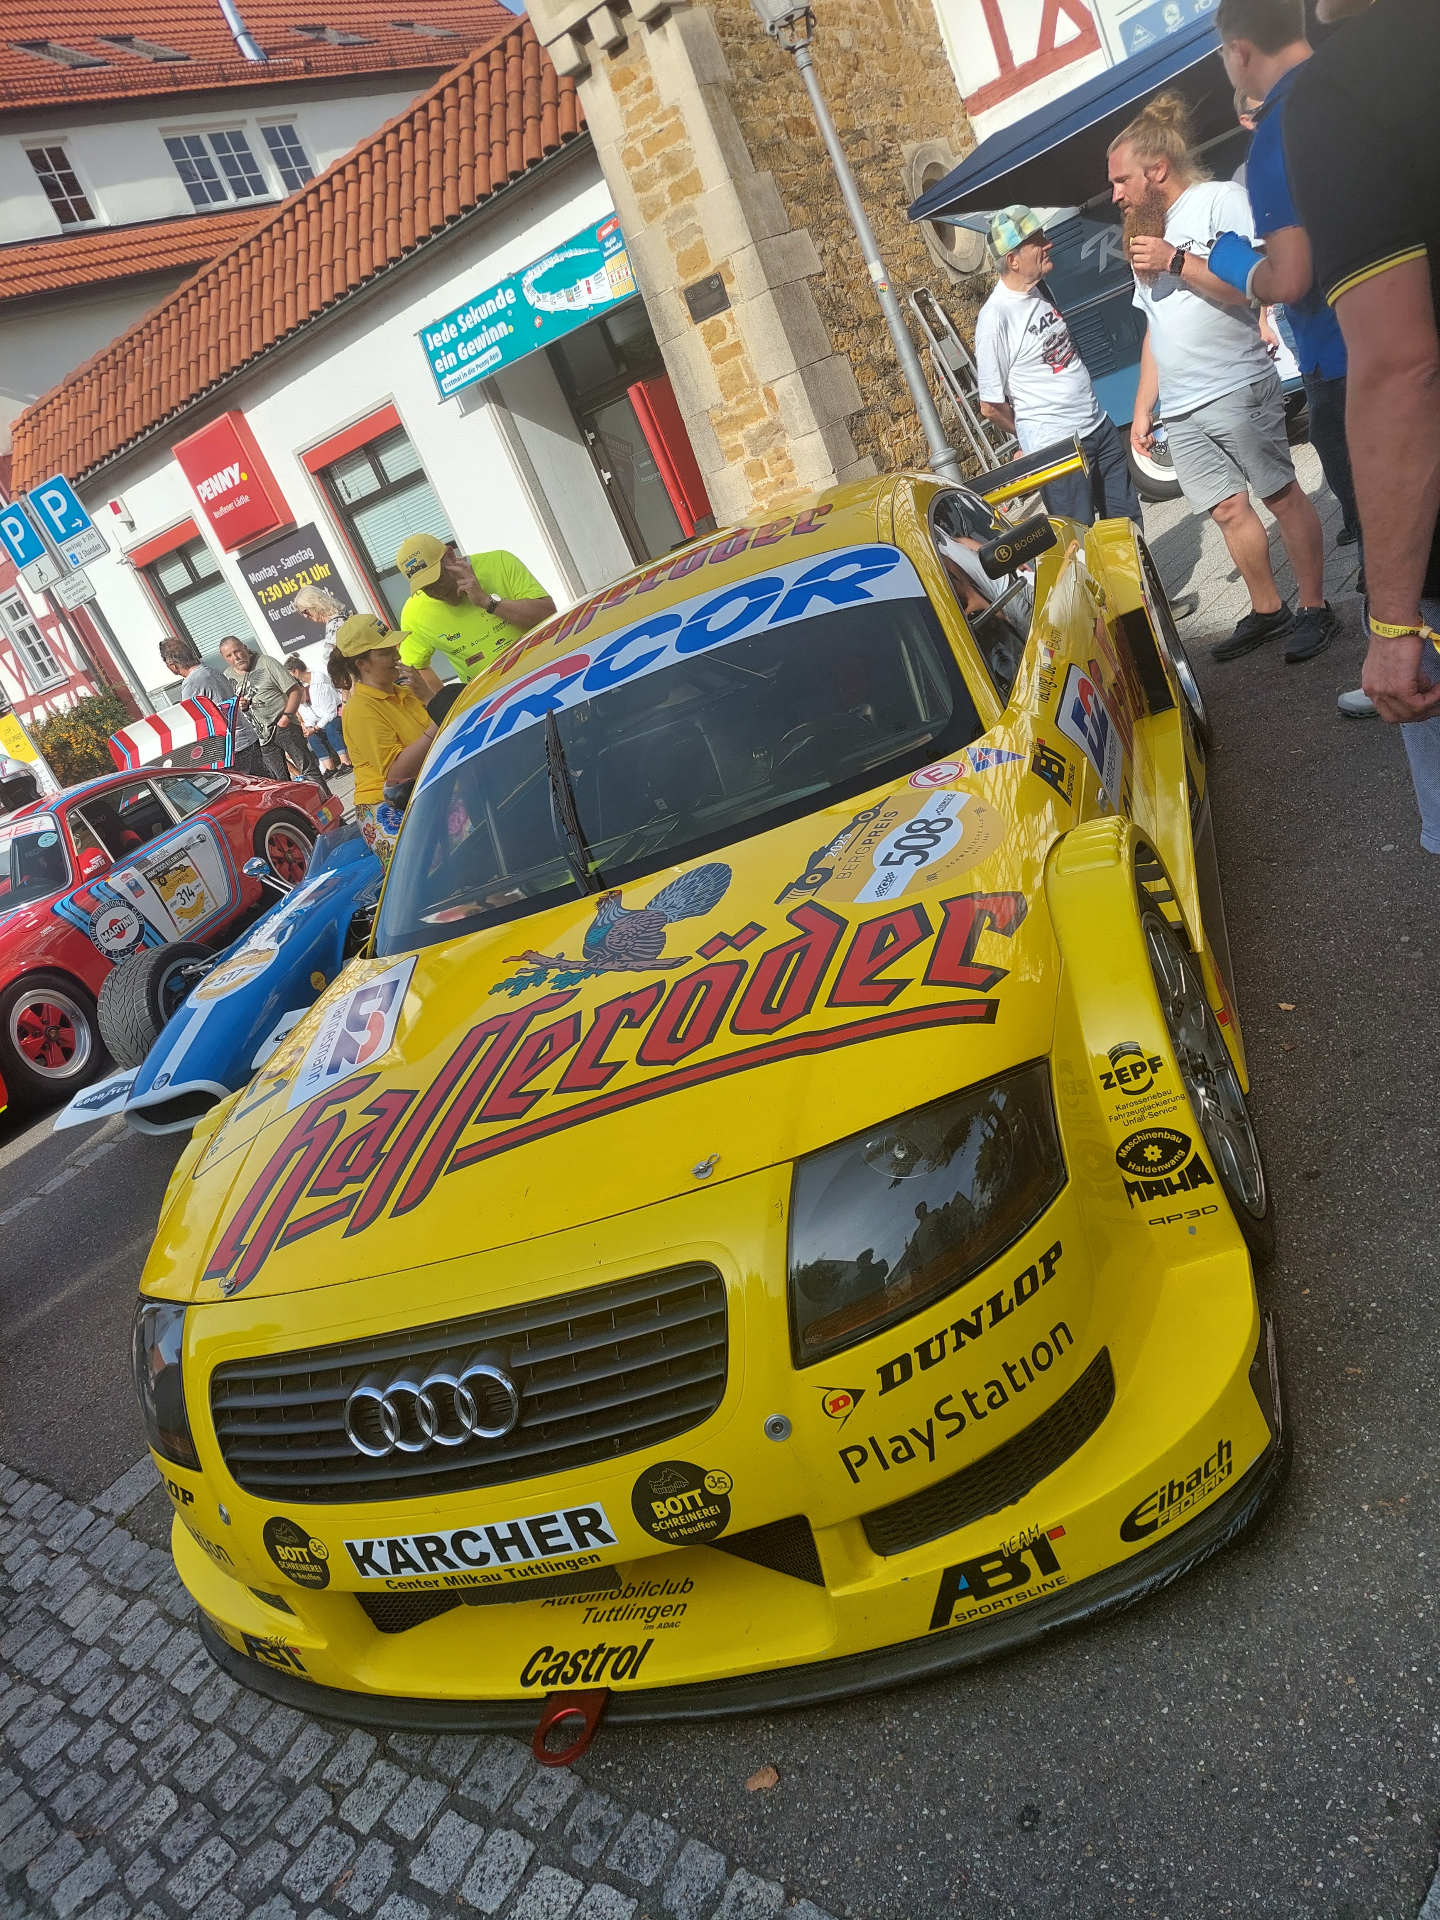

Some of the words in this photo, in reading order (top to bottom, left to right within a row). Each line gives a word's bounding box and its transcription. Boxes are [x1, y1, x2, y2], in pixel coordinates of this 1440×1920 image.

[426, 322, 458, 351] Jede
[457, 287, 516, 333] Sekunde
[434, 350, 458, 373] ein
[457, 321, 514, 360] Gewinn.
[443, 374, 463, 389] Erstmal
[467, 366, 476, 376] die
[475, 358, 490, 373] Penny
[489, 350, 500, 365] App
[39, 489, 68, 535] P
[212, 502, 235, 519] Neuffener
[234, 493, 250, 508] Lädle
[0, 516, 26, 559] P
[83, 542, 102, 558] Stunden
[1013, 526, 1048, 552] BOGNER
[248, 563, 277, 585] Montag
[280, 547, 314, 570] Samstag
[257, 587, 282, 605] 7:30
[281, 577, 299, 595] bis
[296, 572, 312, 589] 21
[311, 563, 331, 582] Uhr
[268, 607, 280, 622] für
[414, 546, 901, 797] ARCOR
[922, 769, 954, 784] E
[1031, 743, 1072, 808] ABT
[1066, 762, 1076, 799] SPORTSLINE
[824, 833, 853, 858] 2025
[836, 810, 900, 880] BERGPREIS
[879, 817, 954, 867] 508
[83, 860, 100, 875] Mobil
[146, 867, 158, 879] ADAC
[176, 886, 196, 906] 314
[91, 900, 128, 924] INTERNATIONAL
[131, 907, 145, 925] CLUB
[90, 925, 108, 955] MARTINI
[100, 914, 135, 944] MARTINI
[306, 996, 350, 1087] mannesmann
[1099, 1055, 1164, 1091] ZEPF
[200, 891, 1030, 1297] Hasseröder
[1108, 1093, 1186, 1123] Fahrzeuglackierung
[1114, 1088, 1172, 1112] Karosseriebau
[1122, 1105, 1178, 1127] Unfall-Service
[1118, 1131, 1183, 1159] Maschinenbau
[1127, 1149, 1186, 1174] Haldenwang
[1120, 1151, 1215, 1210] MAHA
[875, 1240, 1063, 1397] DUNLOP
[828, 1394, 851, 1415] D
[837, 1320, 1075, 1485] PlayStation
[706, 1474, 728, 1490] 35
[1119, 1438, 1233, 1543] Eibach
[1156, 1460, 1233, 1529] FEDERN
[650, 1488, 704, 1519] BOTT
[651, 1504, 721, 1532] SCHREINEREI
[344, 1507, 617, 1577] KÄRCHER
[667, 1531, 679, 1540] in
[679, 1520, 717, 1536] Neuffen
[1000, 1523, 1042, 1558] TEAM
[275, 1544, 311, 1563] BOTT
[310, 1540, 326, 1557] 35
[278, 1560, 323, 1573] SCHREINEREI
[297, 1572, 322, 1581] Neuffen
[385, 1574, 441, 1590] Center
[443, 1570, 503, 1587] Milkau
[504, 1552, 602, 1578] Tuttlingen
[927, 1530, 1063, 1632] ABT
[954, 1574, 1070, 1623] SPORTSLINE
[582, 1603, 688, 1625] Tuttlingen
[656, 1621, 681, 1630] ADAC
[240, 1631, 308, 1673] ABT
[520, 1638, 655, 1688] Castrol
